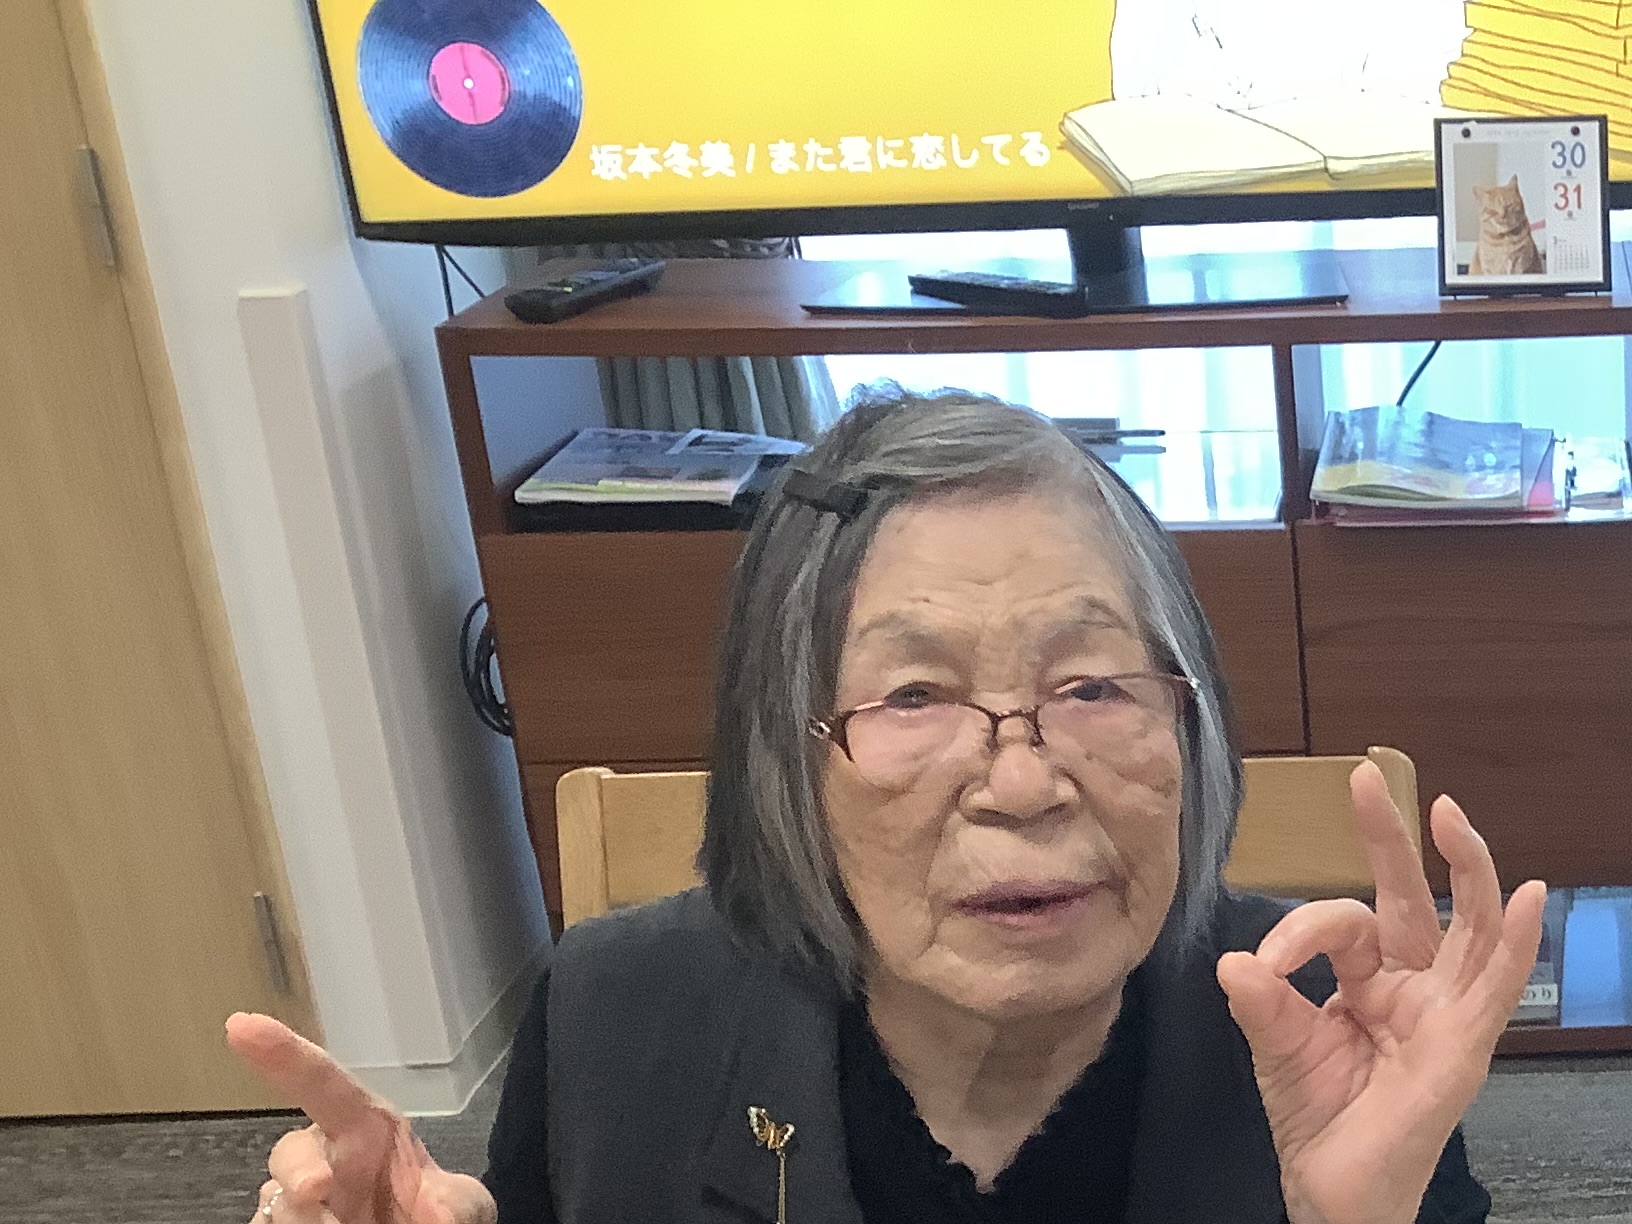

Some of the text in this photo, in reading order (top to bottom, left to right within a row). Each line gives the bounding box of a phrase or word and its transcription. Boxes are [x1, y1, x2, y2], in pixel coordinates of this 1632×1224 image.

[589, 138, 737, 181] 坂本冬美
[767, 132, 1051, 175] また君に恋してる
[1551, 140, 1586, 168] 30
[1553, 182, 1583, 211] 31
